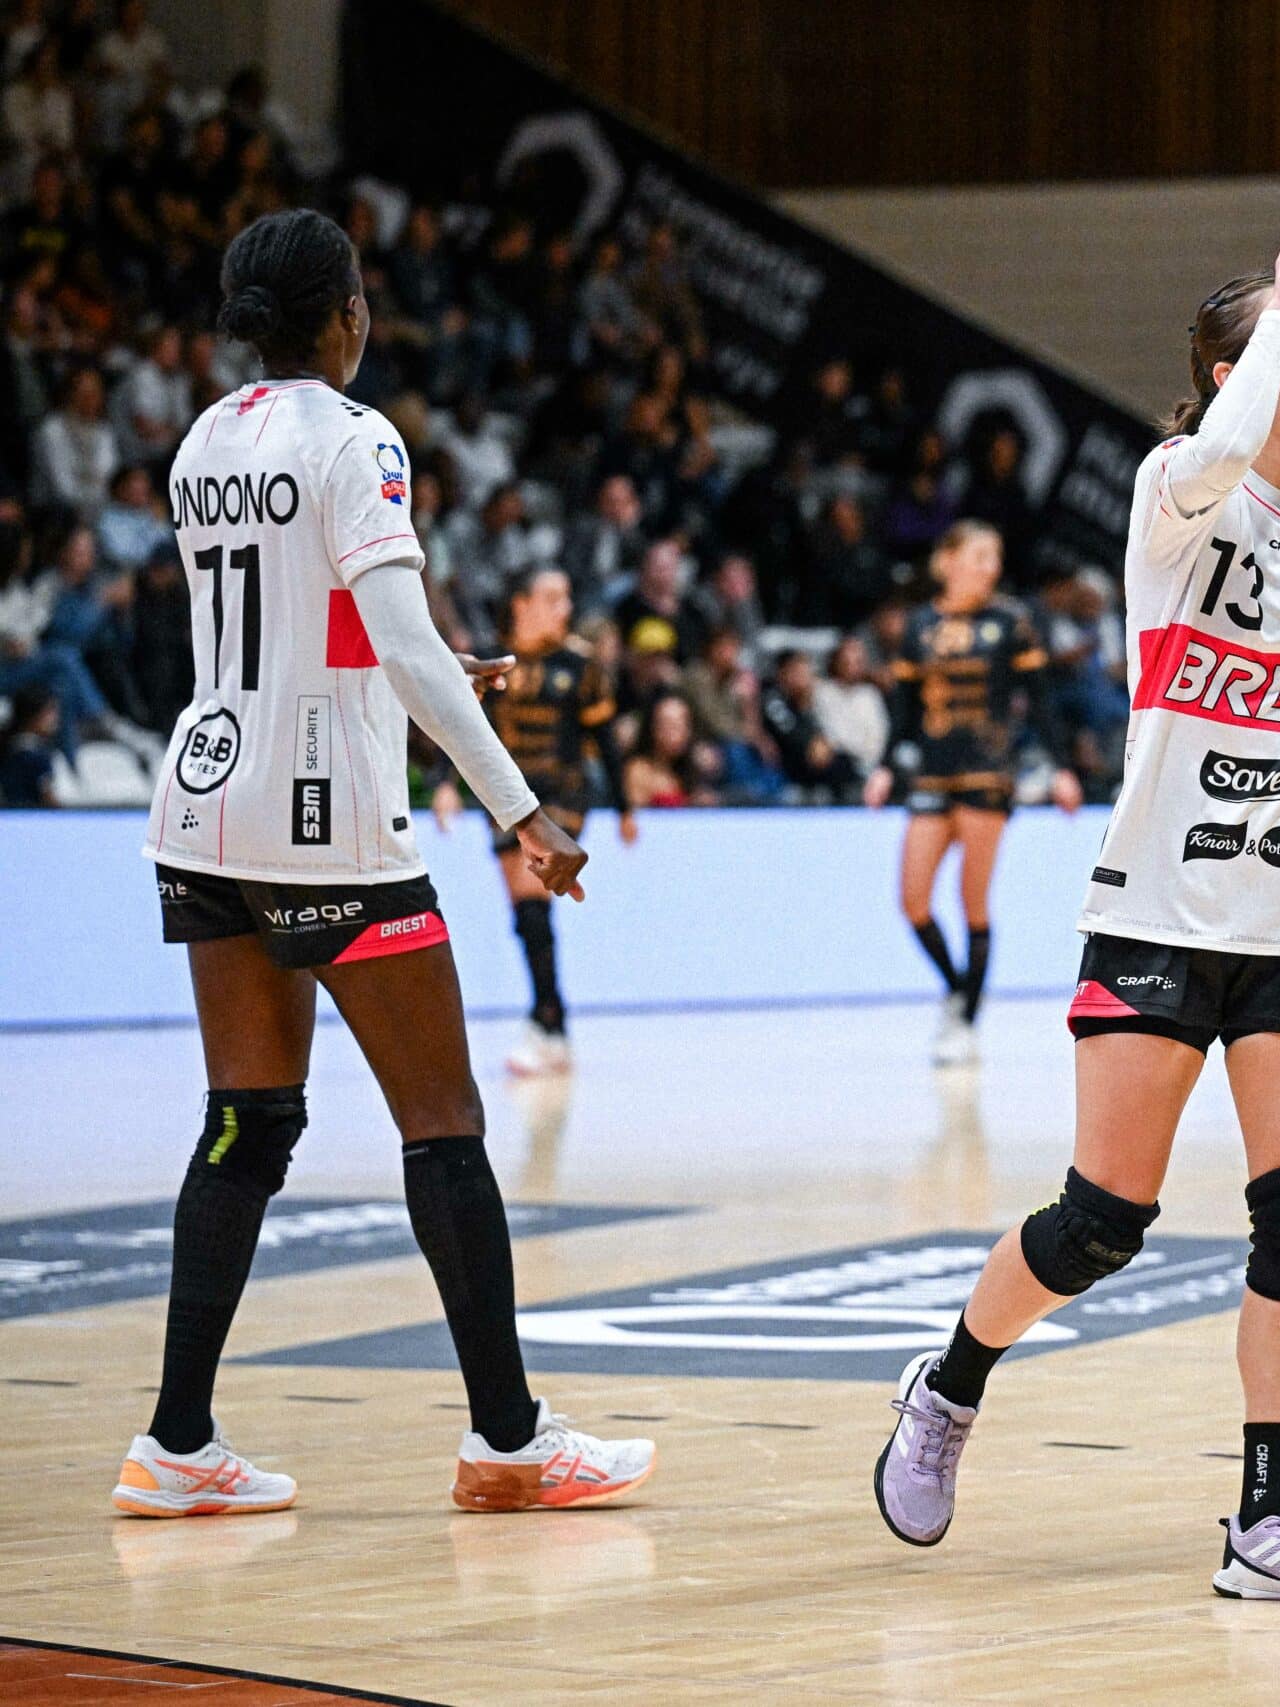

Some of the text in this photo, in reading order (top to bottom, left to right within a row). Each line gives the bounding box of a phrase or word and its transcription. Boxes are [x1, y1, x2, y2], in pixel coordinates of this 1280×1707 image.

[1200, 537, 1264, 631] 13
[194, 544, 261, 691] 11
[189, 732, 233, 763] B&B
[306, 707, 318, 770] SECURITE
[1189, 831, 1257, 856] Knorr &
[264, 901, 363, 926] virage
[380, 915, 427, 938] BREST
[1117, 976, 1162, 986] CRAFT
[1257, 1444, 1268, 1484] CRAFT
